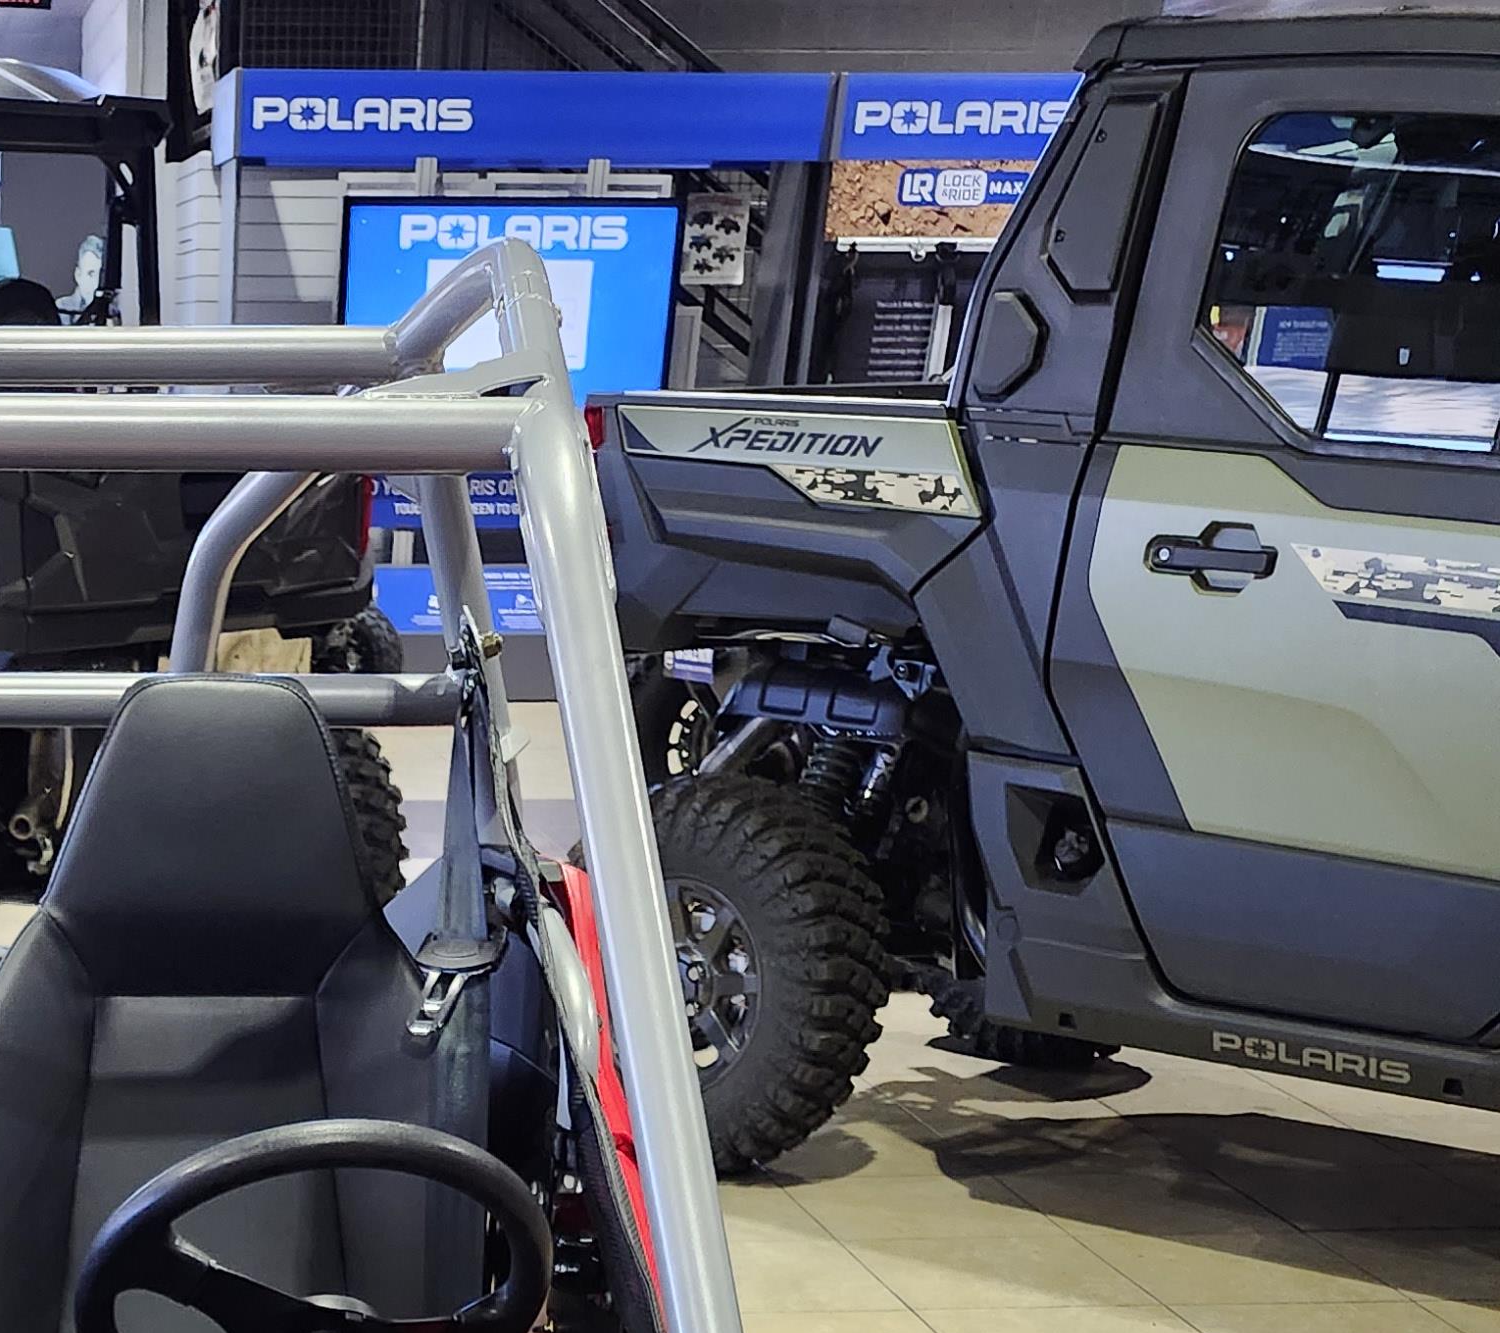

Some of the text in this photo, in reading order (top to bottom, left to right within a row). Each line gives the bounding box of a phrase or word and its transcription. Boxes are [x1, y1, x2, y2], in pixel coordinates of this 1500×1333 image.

[252, 96, 474, 132] POLARIS
[853, 101, 1071, 135] POLARIS
[943, 175, 982, 188] LOCK
[687, 417, 884, 458] XPEDITION
[754, 416, 800, 428] POLARIS
[1211, 1031, 1412, 1084] POLARIS
